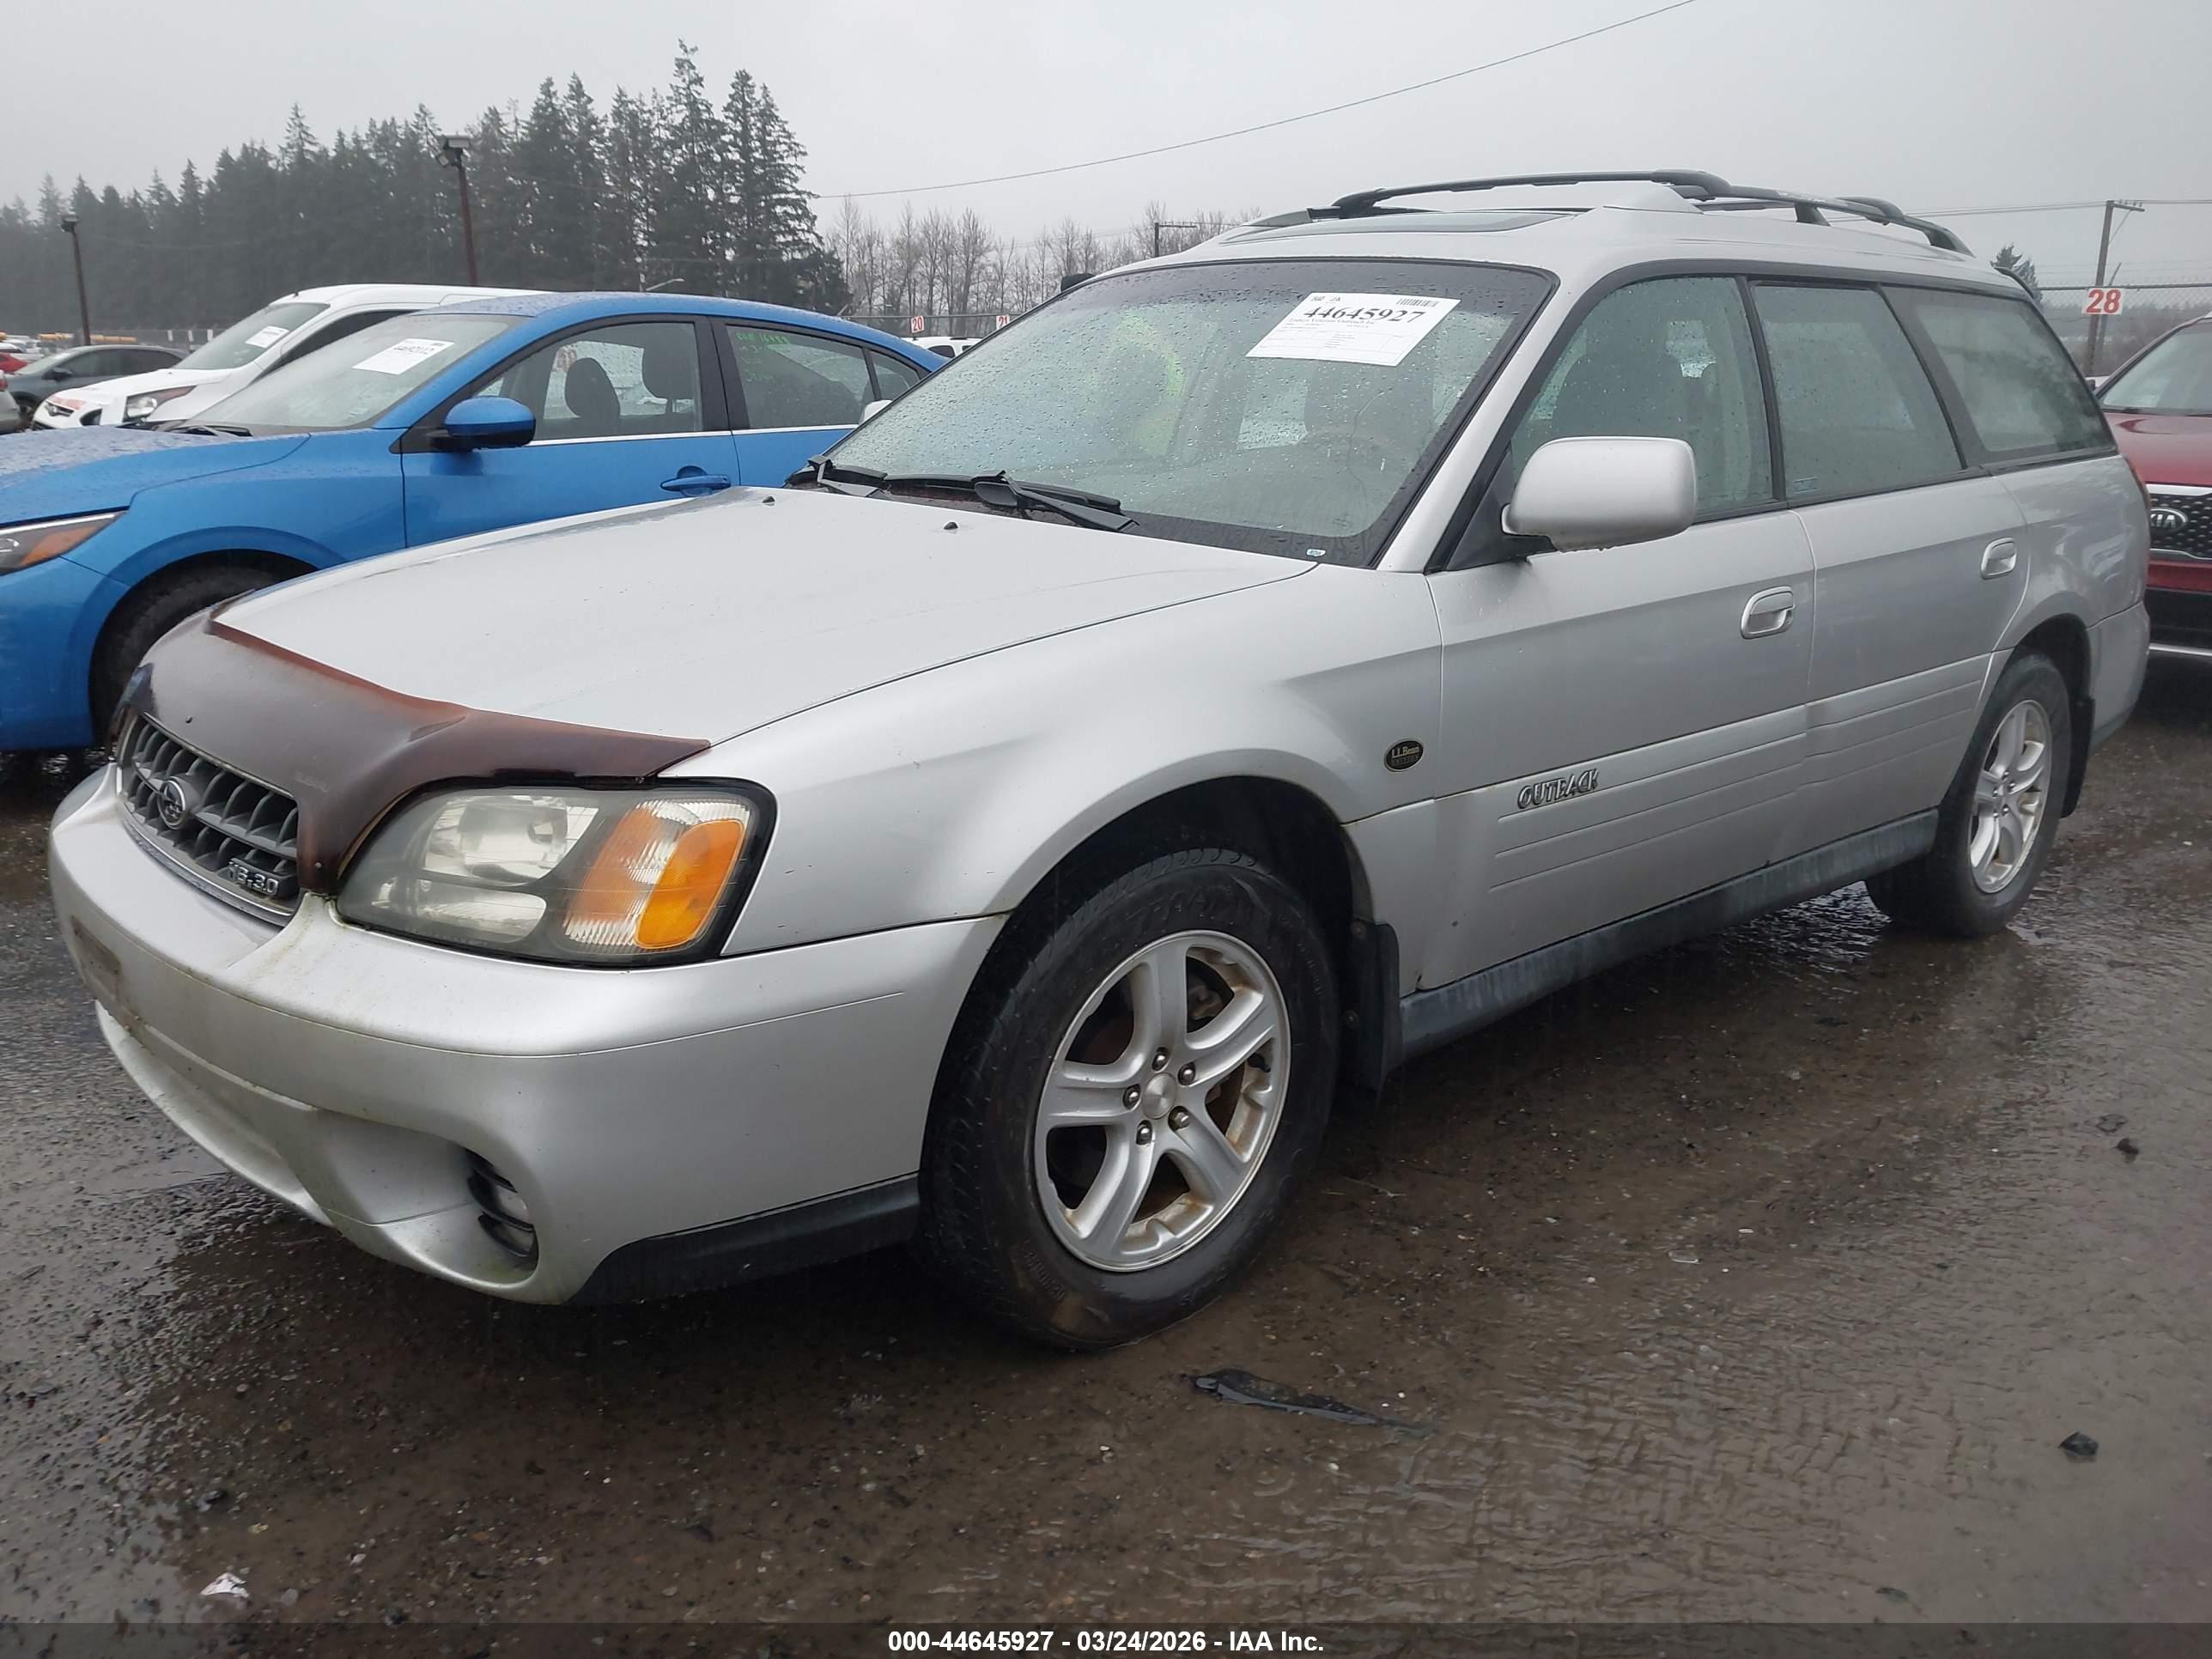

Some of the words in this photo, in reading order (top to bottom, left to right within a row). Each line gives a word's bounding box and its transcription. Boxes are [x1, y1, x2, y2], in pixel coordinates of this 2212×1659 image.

[2087, 289, 2121, 313] 28
[1303, 307, 1426, 323] 44645927
[912, 317, 923, 332] 20
